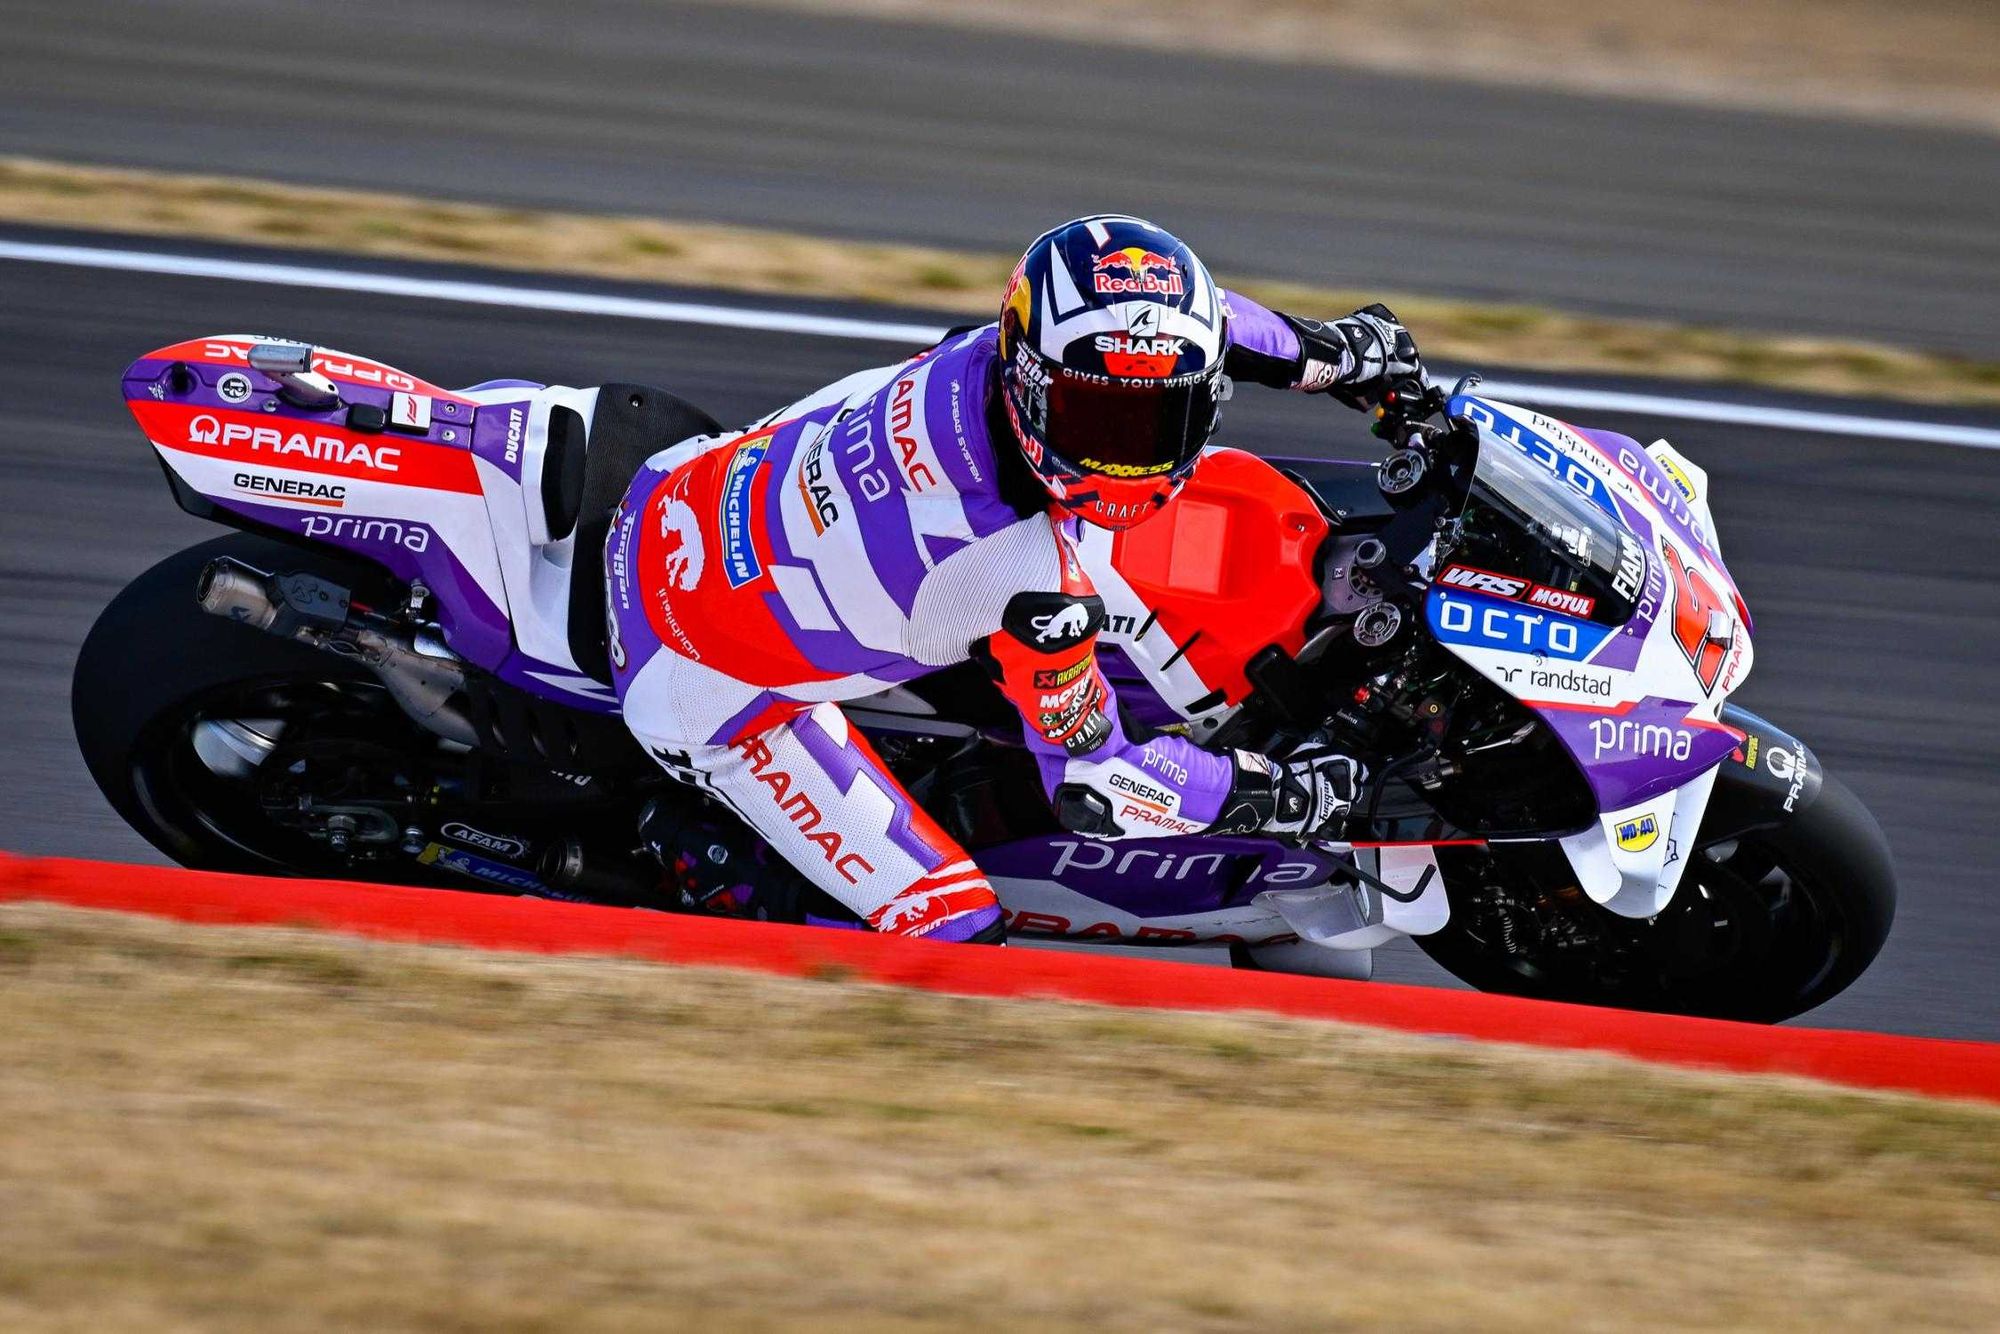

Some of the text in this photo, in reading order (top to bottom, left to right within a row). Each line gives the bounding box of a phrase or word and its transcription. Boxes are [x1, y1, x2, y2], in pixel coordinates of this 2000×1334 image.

[1094, 272, 1183, 295] Red Bull
[1094, 335, 1184, 357] SHARK
[1062, 366, 1210, 389] GIVES YOU WINGS
[221, 423, 402, 473] PRAMAC
[503, 407, 523, 465] DUCATI
[950, 394, 982, 484] AIRBAG SYSTEM
[1463, 400, 1596, 498] OCTO
[233, 473, 346, 499] GENERAC
[727, 473, 751, 580] MICHELIN
[1096, 501, 1150, 522] CRAFT
[300, 515, 431, 554] prima
[1439, 567, 1526, 597] WRS
[1529, 586, 1592, 616] MOTUL
[1440, 601, 1578, 655] OCTO
[1529, 668, 1612, 698] randstad
[1066, 707, 1102, 748] CRAFT
[1588, 716, 1693, 762] prima
[1143, 746, 1189, 787] prima
[1782, 740, 1806, 813] PRAMAC
[1108, 773, 1176, 809] GENERAC
[1120, 804, 1200, 836] PRAMAC
[452, 827, 512, 854] AFAM
